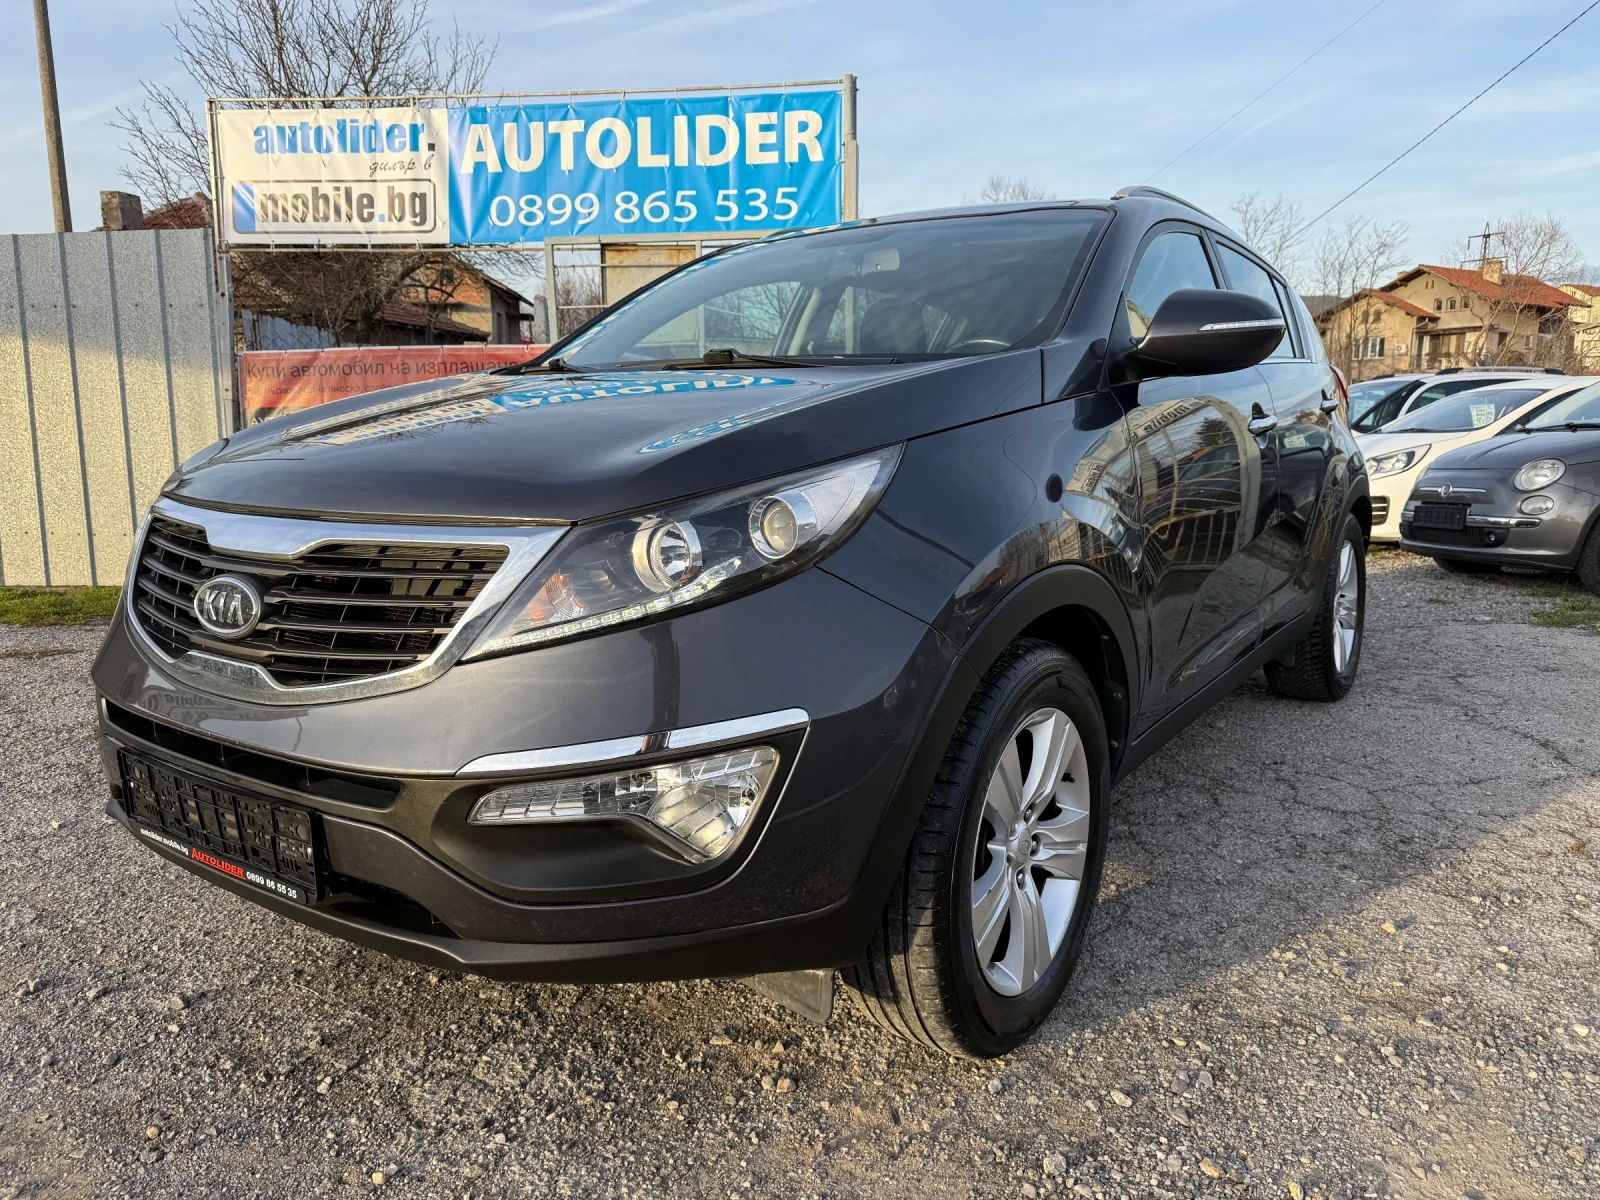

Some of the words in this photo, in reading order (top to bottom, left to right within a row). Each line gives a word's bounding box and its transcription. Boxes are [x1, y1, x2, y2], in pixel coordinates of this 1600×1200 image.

[460, 110, 824, 174] AUTOLIDER
[259, 185, 428, 227] mobile.bg
[489, 192, 600, 228] 0899
[613, 189, 698, 224] 865
[713, 186, 799, 222] 535
[247, 363, 286, 382] Купи
[291, 360, 384, 378] автомобил
[390, 362, 411, 375] на
[416, 361, 517, 375] изплащан
[203, 588, 244, 625] KIA
